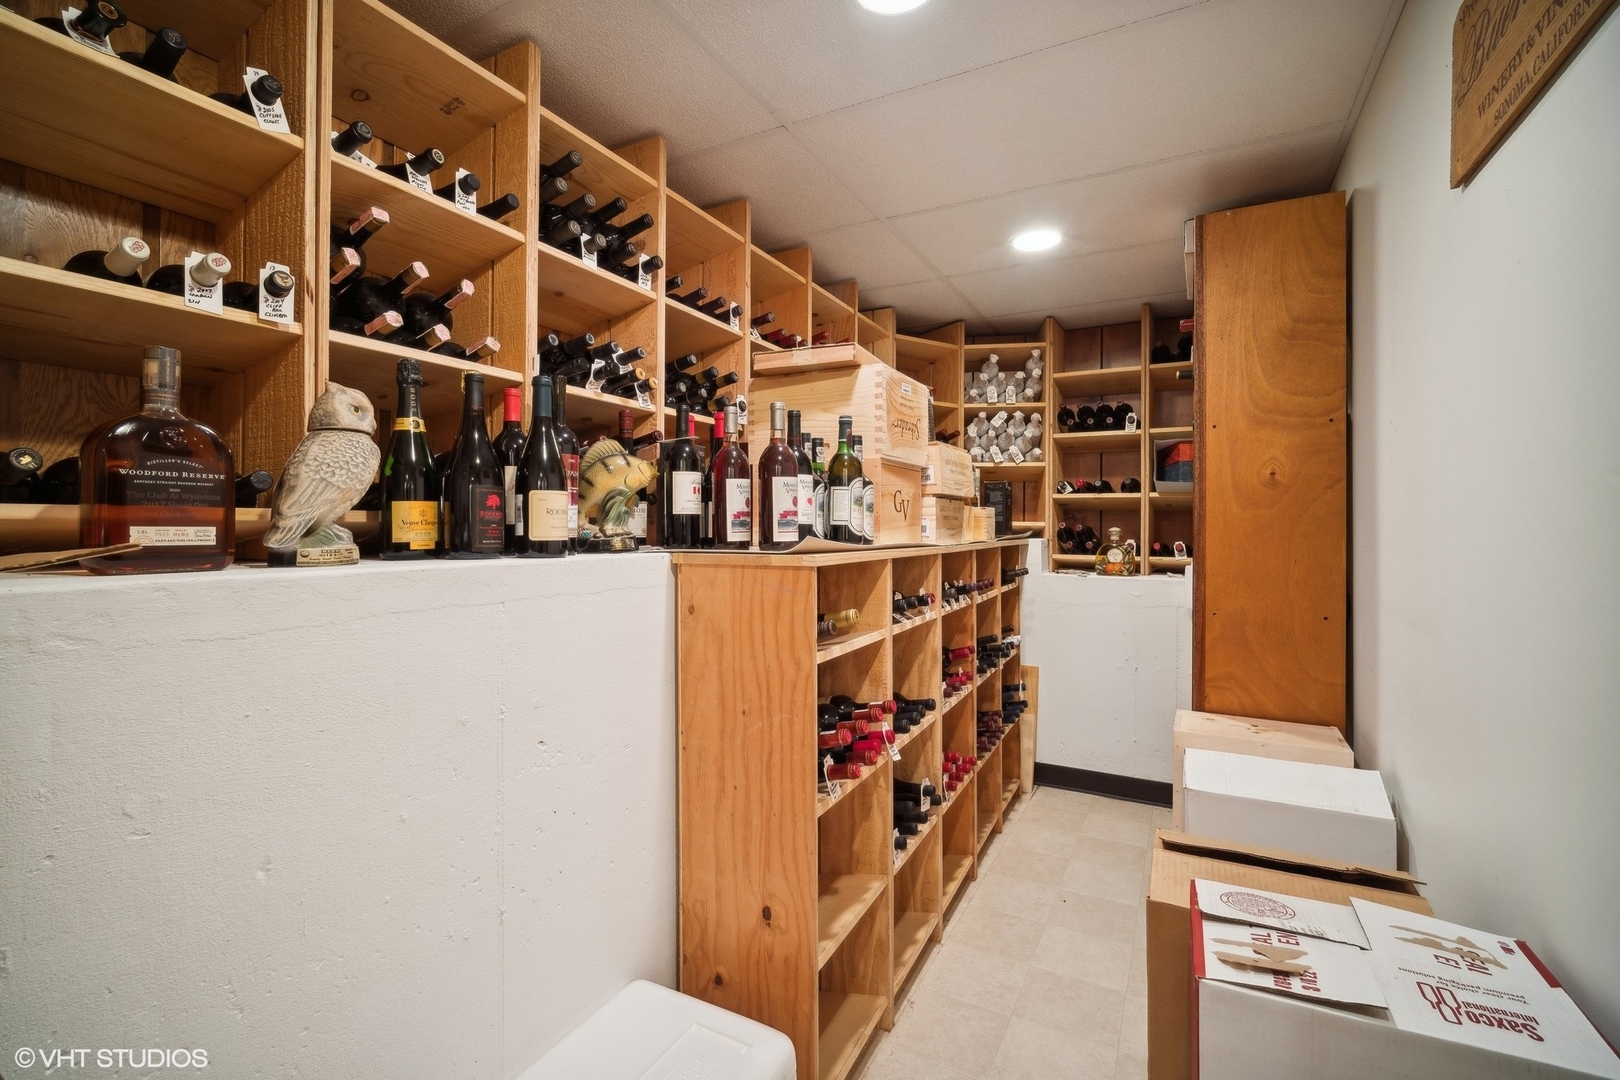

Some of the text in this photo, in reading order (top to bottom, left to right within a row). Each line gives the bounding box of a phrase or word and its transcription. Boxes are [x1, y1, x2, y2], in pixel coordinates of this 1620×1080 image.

[1493, 0, 1596, 127] SONOMA, CALIFORN
[1477, 41, 1526, 119] WINERY
[1522, 34, 1535, 55] &
[118, 468, 226, 480] WOODFORD RESERVE
[126, 491, 143, 499] The
[147, 491, 168, 499] Club
[1397, 966, 1526, 1000] premium packaging solutions
[1451, 985, 1480, 995] choice
[1482, 991, 1504, 999] clear
[1507, 996, 1530, 1006] Your
[1461, 1001, 1540, 1026] International
[1463, 1009, 1545, 1042] Saxco
